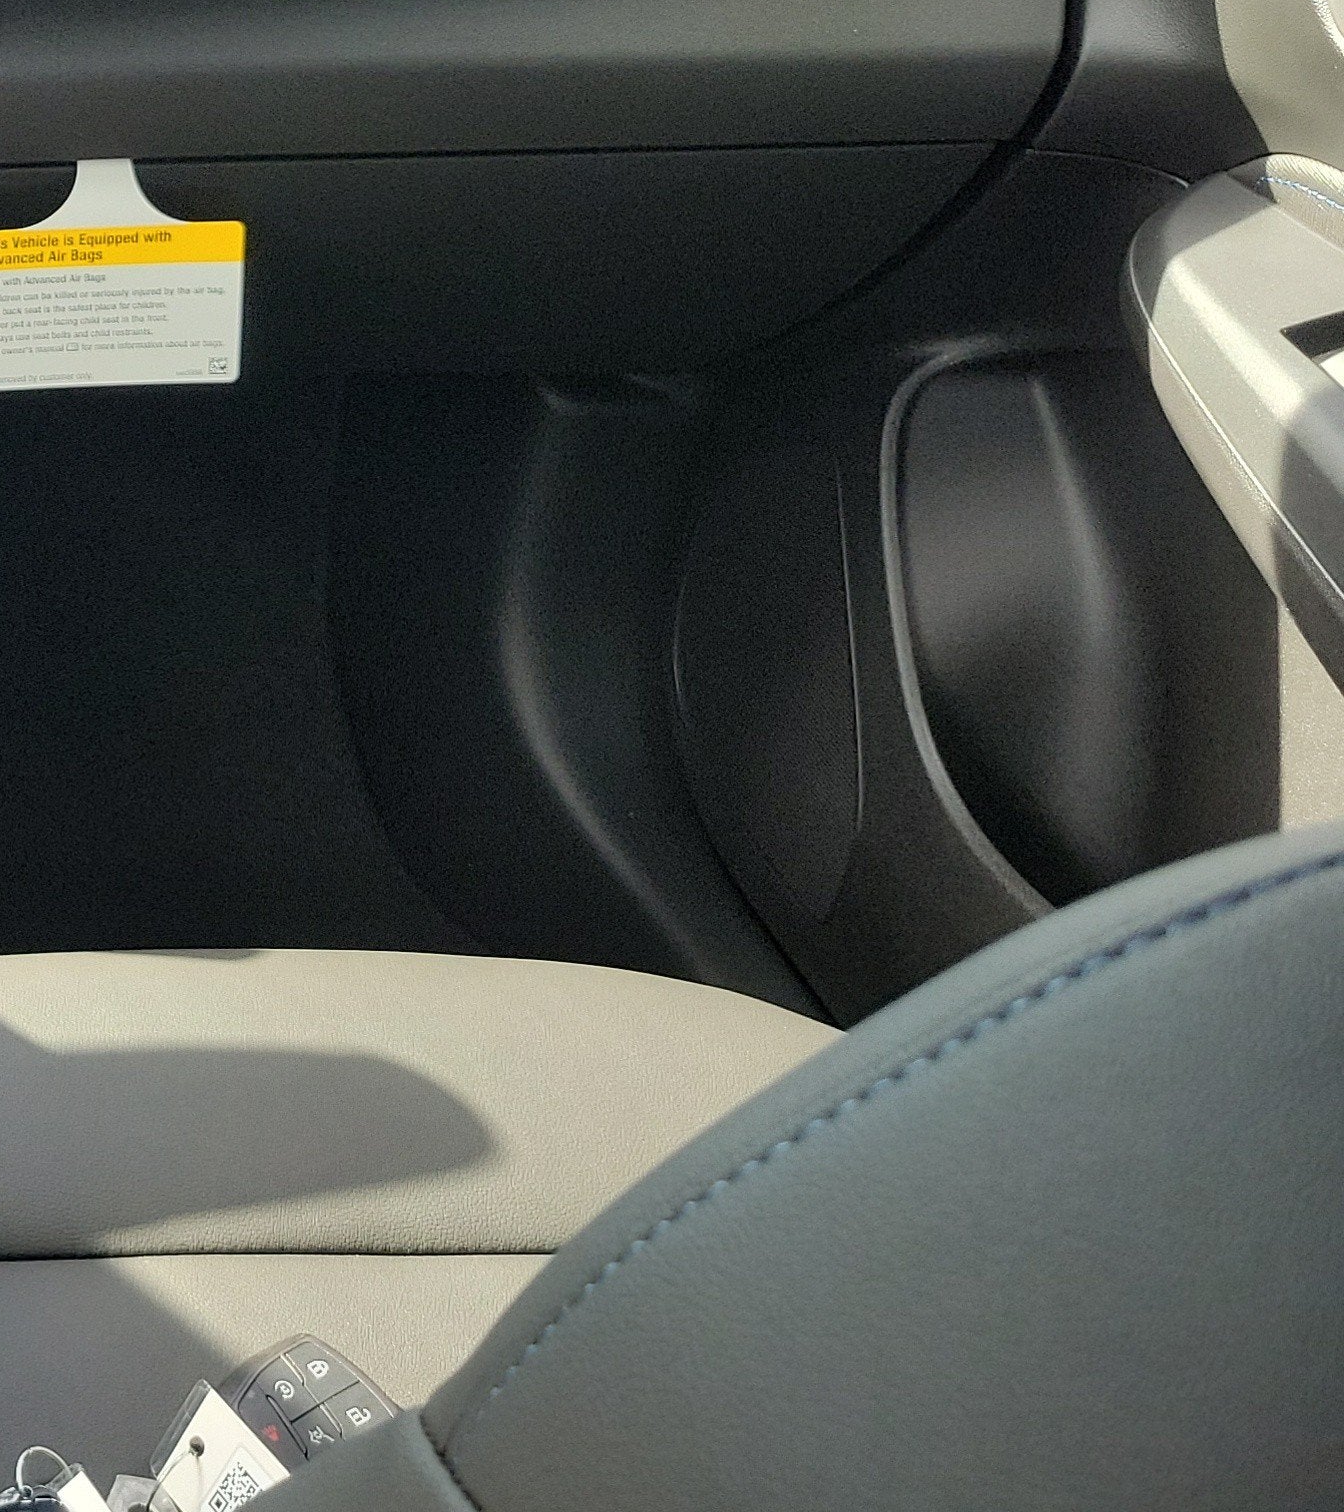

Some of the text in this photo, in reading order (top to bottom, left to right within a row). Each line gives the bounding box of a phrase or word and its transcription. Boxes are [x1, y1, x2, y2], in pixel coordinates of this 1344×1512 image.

[12, 235, 59, 249] Vehicle
[63, 234, 74, 246] is
[79, 232, 139, 247] Equipped
[144, 230, 172, 242] with
[48, 250, 66, 262] Air
[71, 249, 103, 263] Bags
[3, 277, 21, 286] with
[24, 274, 67, 285] Advanced
[70, 274, 81, 283] Air
[84, 273, 106, 283] Bags
